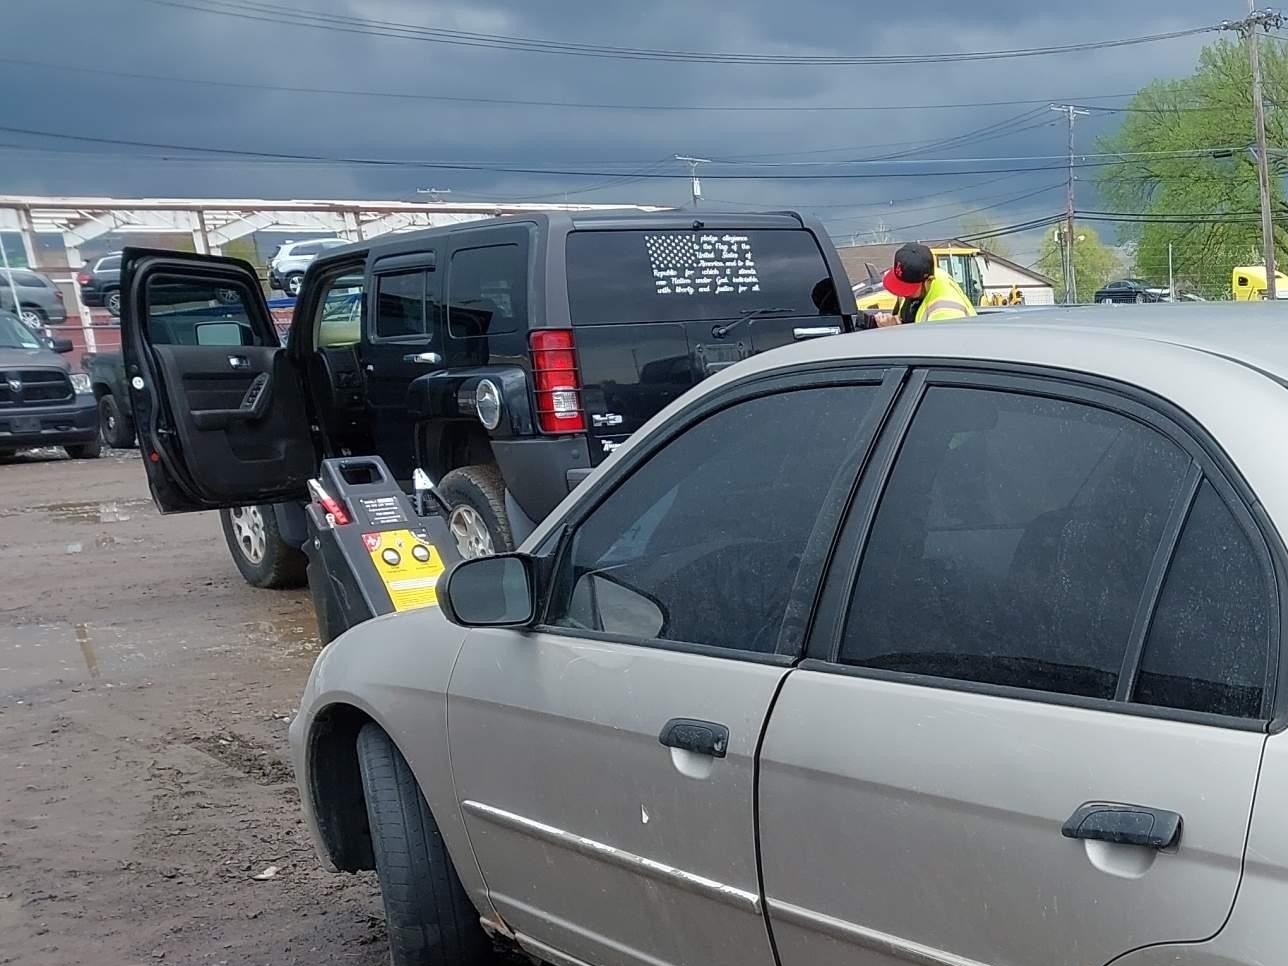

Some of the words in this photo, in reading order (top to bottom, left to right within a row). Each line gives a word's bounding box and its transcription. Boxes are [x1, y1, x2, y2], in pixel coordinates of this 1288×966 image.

[731, 243, 738, 252] of
[745, 251, 752, 260] of
[725, 259, 737, 267] and
[684, 268, 695, 278] for
[670, 277, 691, 285] Nation
[657, 286, 671, 294] with
[675, 286, 694, 295] liberty
[714, 285, 735, 294] justice
[738, 284, 749, 294] for
[592, 413, 622, 426] H3
